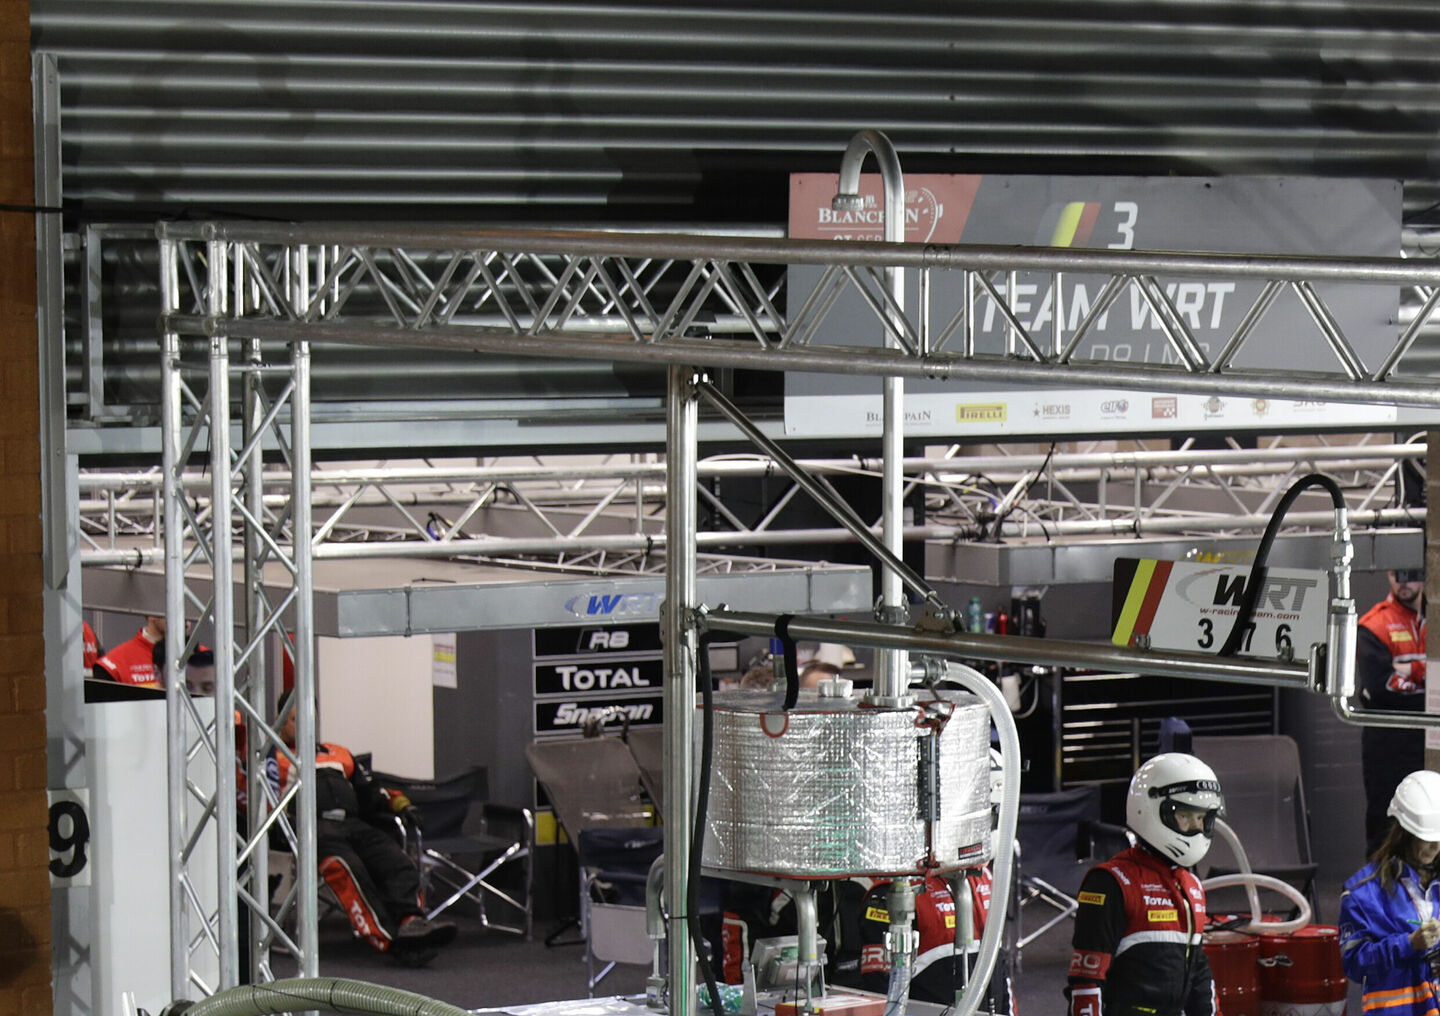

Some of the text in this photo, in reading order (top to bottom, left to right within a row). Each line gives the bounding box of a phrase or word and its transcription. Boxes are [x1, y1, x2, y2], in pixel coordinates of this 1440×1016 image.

[1108, 202, 1138, 250] 3
[982, 282, 1235, 332] TEAM WRT
[960, 406, 1003, 420] PIRELLI
[588, 631, 630, 649] R8
[1197, 618, 1214, 649] 3
[555, 665, 651, 691] TOTAL
[1143, 895, 1174, 907] TOTAL
